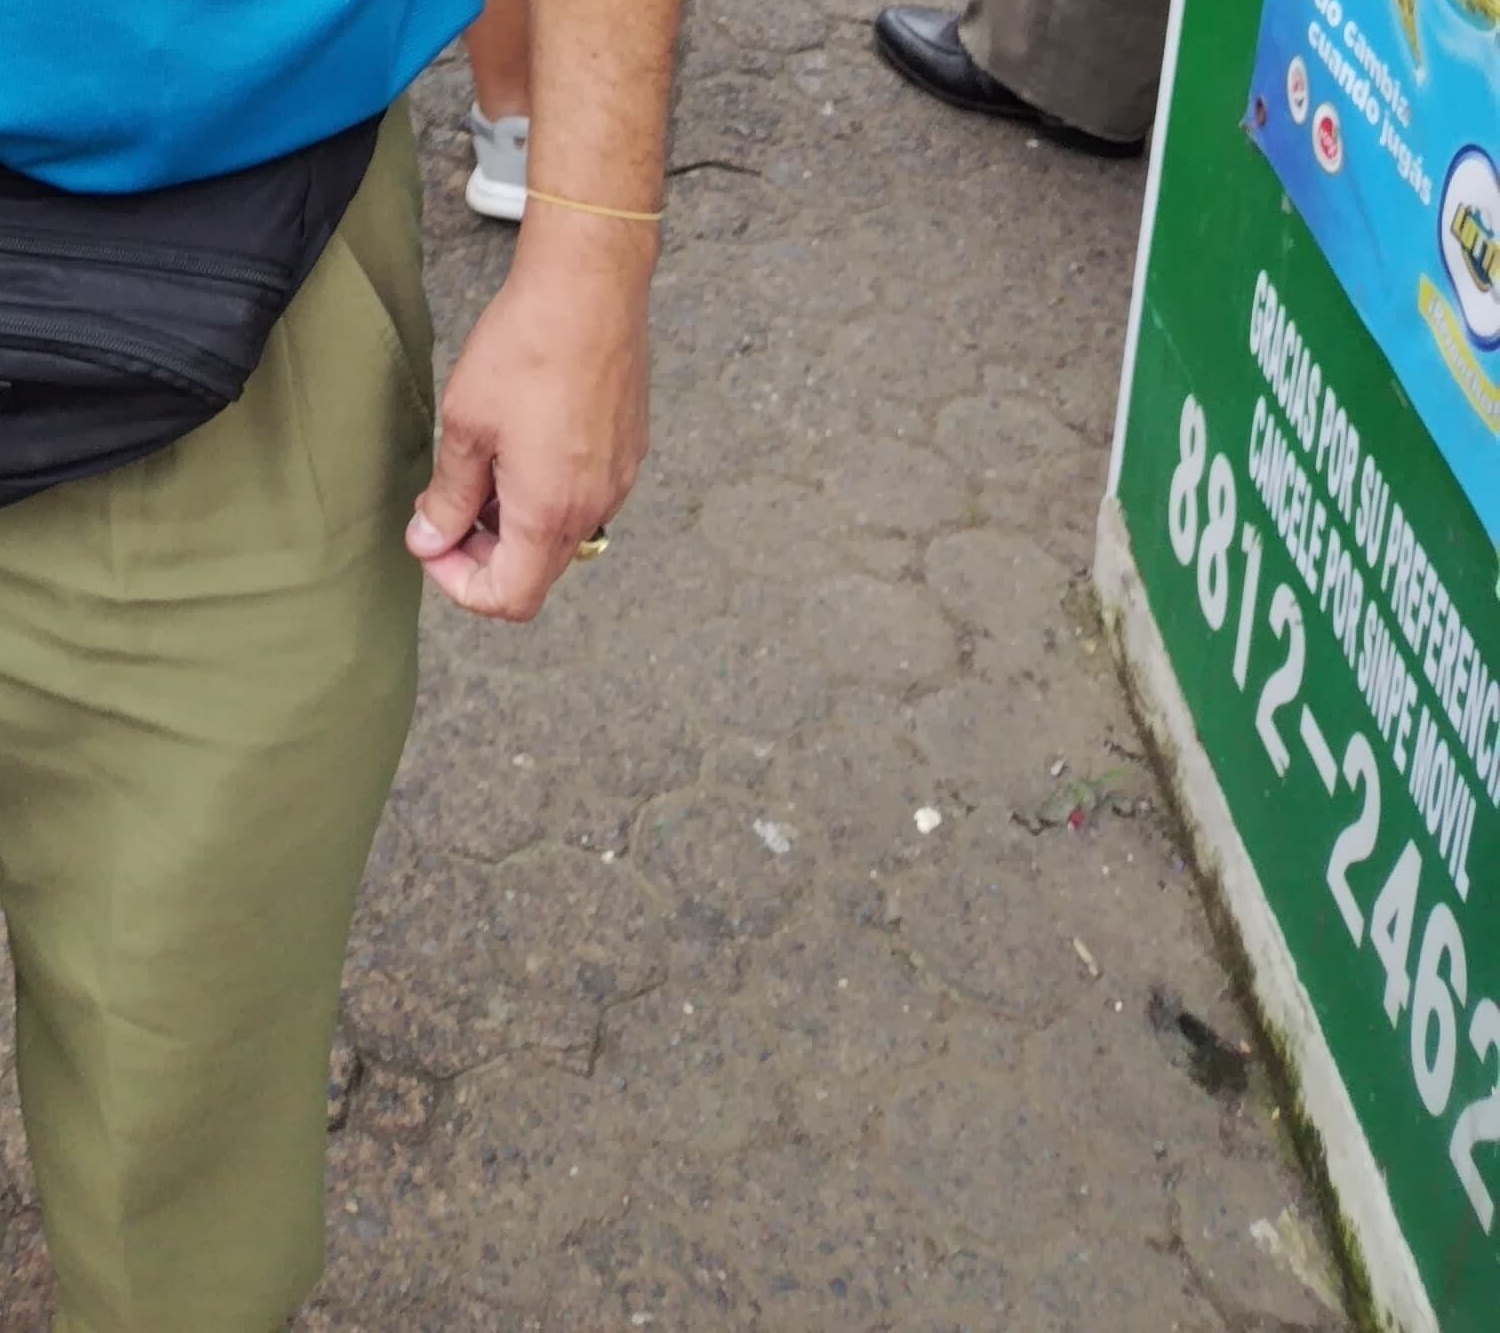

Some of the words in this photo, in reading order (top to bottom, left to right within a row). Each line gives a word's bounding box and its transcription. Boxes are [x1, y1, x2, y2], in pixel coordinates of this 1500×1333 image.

[1308, 21, 1380, 125] cuando
[1380, 109, 1432, 206] jugás
[1344, 20, 1411, 129] cambia
[1250, 269, 1321, 453] GRACIAS
[1316, 385, 1360, 526] POR
[1355, 454, 1389, 569] SU
[1249, 395, 1327, 595] CANCELE
[1320, 527, 1364, 669] POR
[1357, 600, 1418, 775] SINPE
[1409, 704, 1476, 904] MOVIL
[1168, 393, 1500, 1237] 8812-2462
